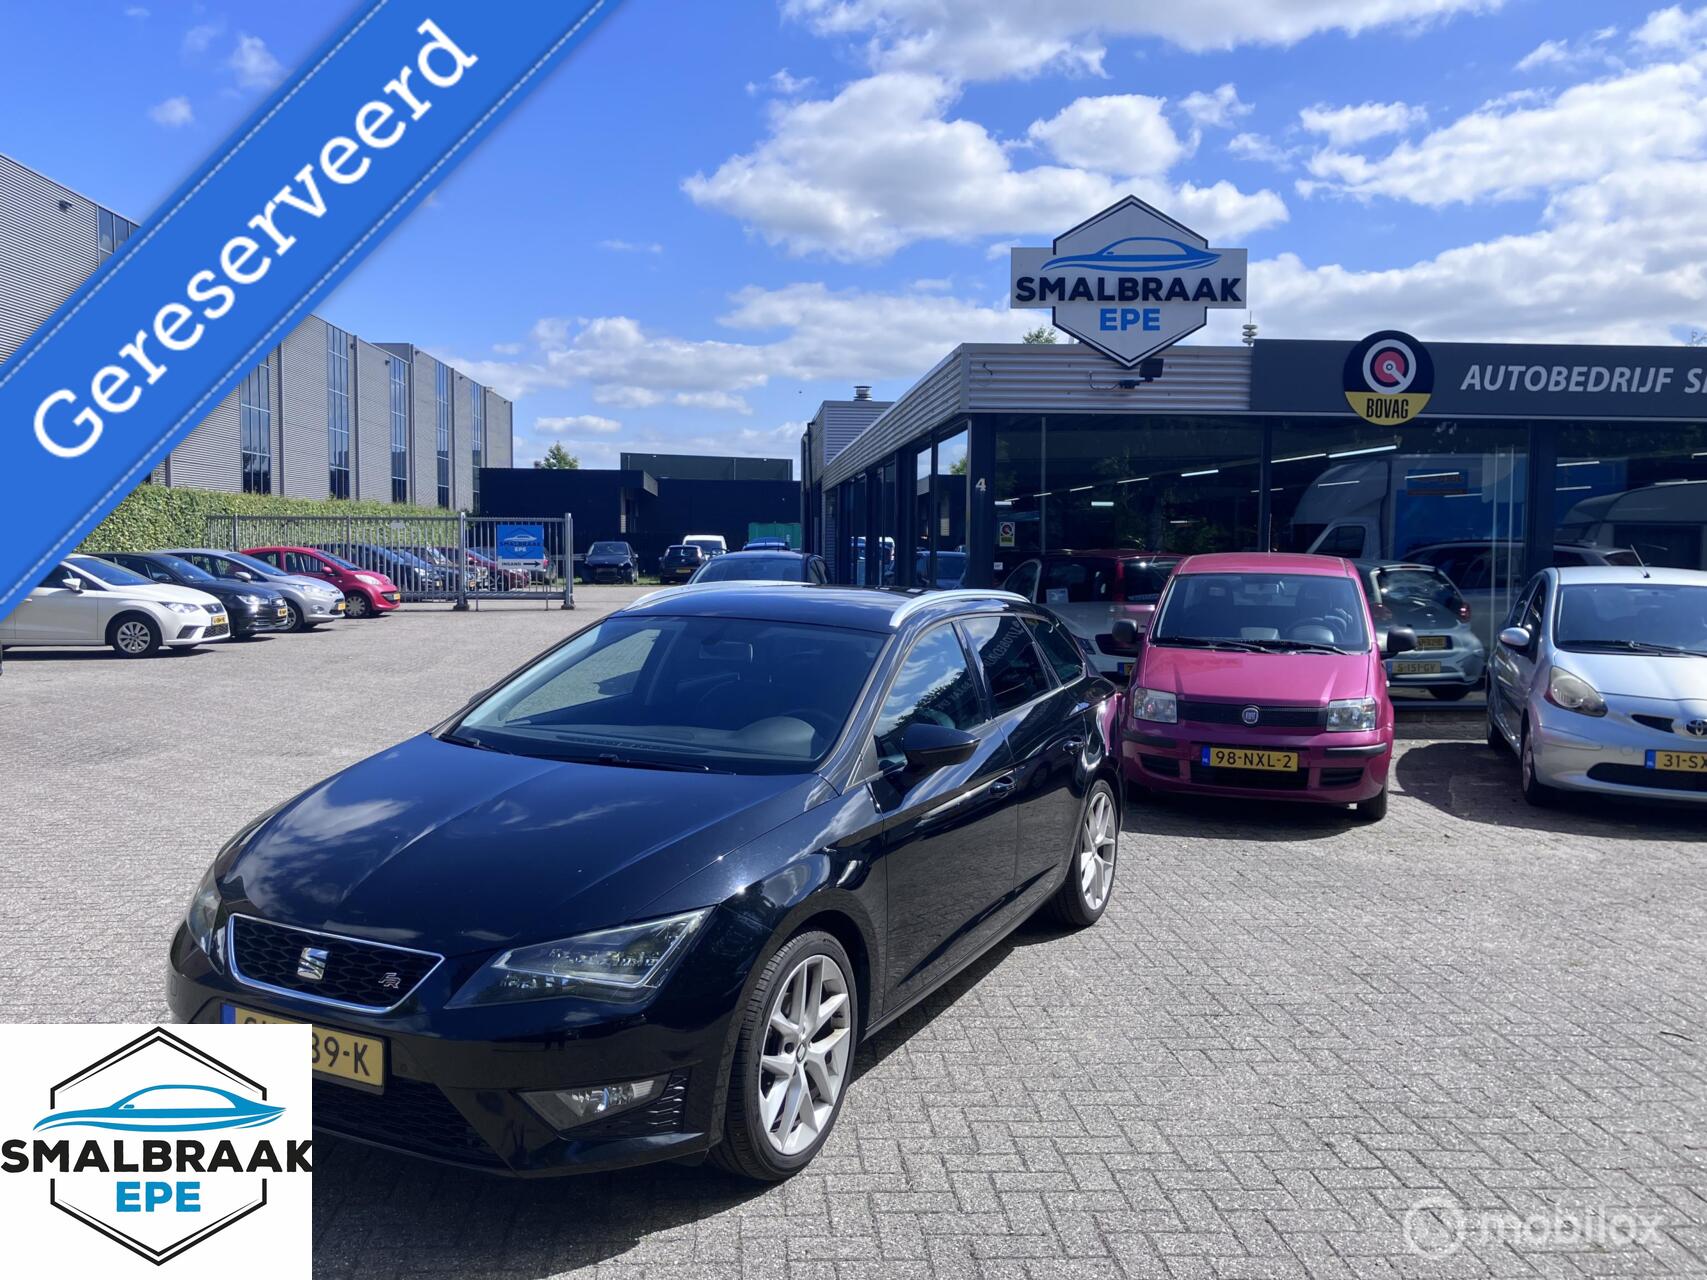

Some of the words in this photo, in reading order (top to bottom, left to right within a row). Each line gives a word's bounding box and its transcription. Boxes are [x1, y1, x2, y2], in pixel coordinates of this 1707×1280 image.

[1015, 276, 1242, 302] SMALBRAAK
[1100, 308, 1161, 331] EPE
[1460, 365, 1674, 393] AUTOBEDRIJF
[1684, 367, 1707, 394] S
[1366, 398, 1409, 419] BOVAG
[975, 478, 987, 492] 4
[1215, 750, 1292, 769] 98-NXL-2
